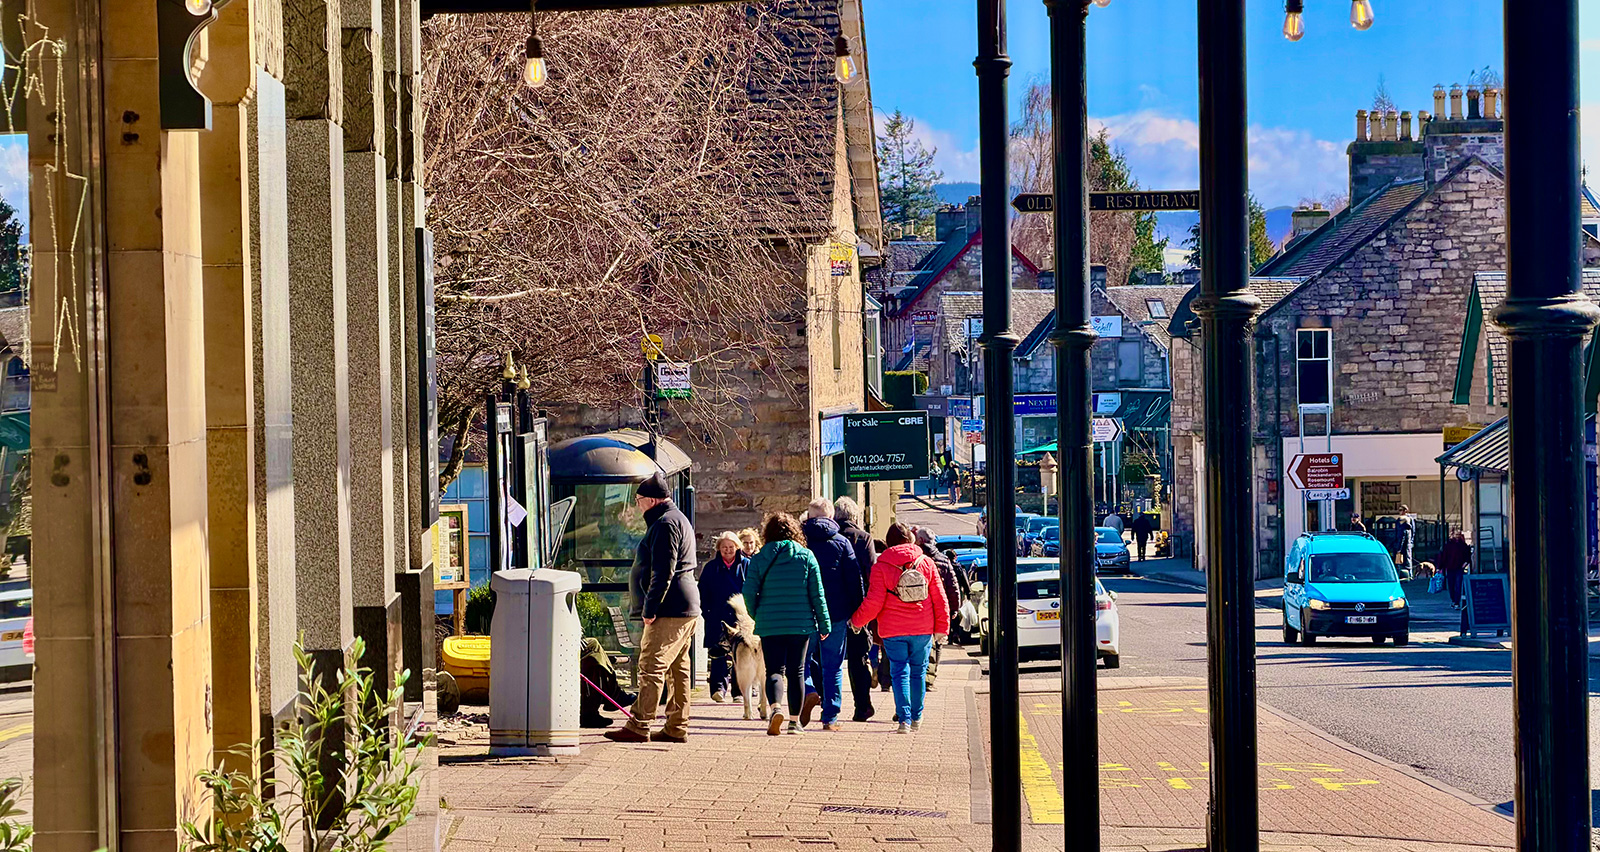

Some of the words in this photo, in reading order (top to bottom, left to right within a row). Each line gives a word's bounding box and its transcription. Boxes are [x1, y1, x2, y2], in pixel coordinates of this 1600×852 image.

[1027, 197, 1053, 210] OLD
[1106, 193, 1198, 208] RESTAURANT
[847, 418, 861, 427] For
[862, 417, 879, 427] Sale
[898, 416, 924, 426] CBRE
[849, 455, 867, 464] 0141
[868, 454, 885, 463] 204
[886, 453, 906, 463] 7757
